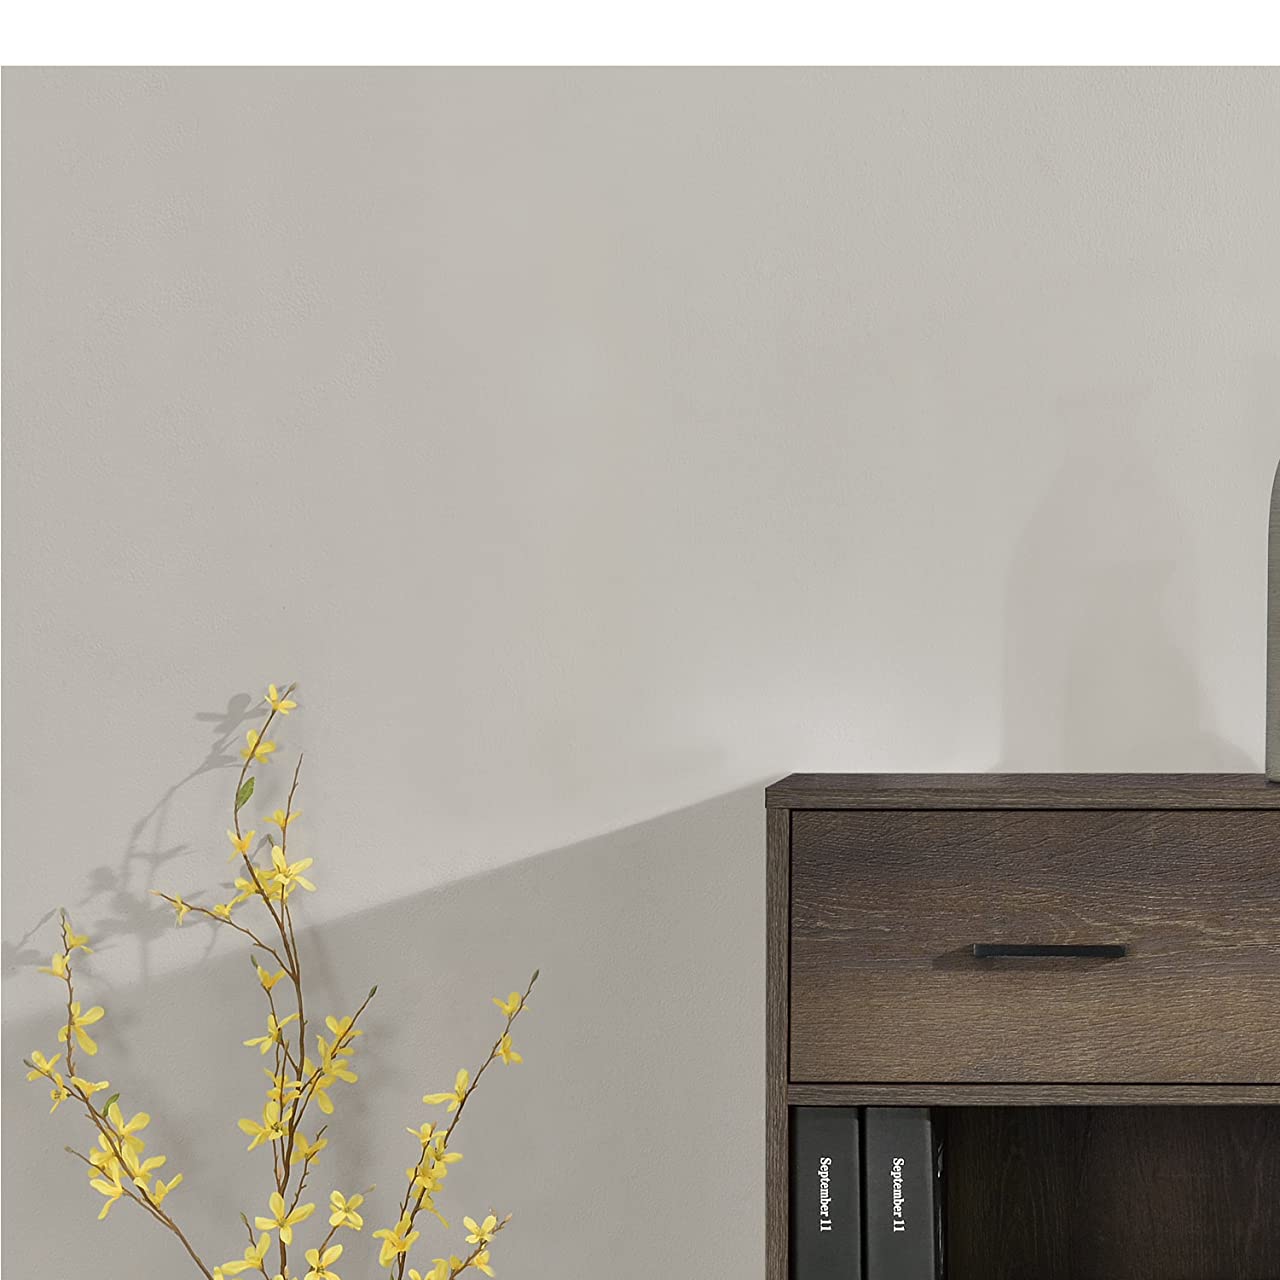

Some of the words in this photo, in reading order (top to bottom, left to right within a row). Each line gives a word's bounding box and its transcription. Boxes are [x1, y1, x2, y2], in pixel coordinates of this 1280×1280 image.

[818, 1157, 832, 1217] September
[890, 1157, 905, 1217] September
[819, 1219, 832, 1232] 11
[893, 1219, 905, 1232] 11
